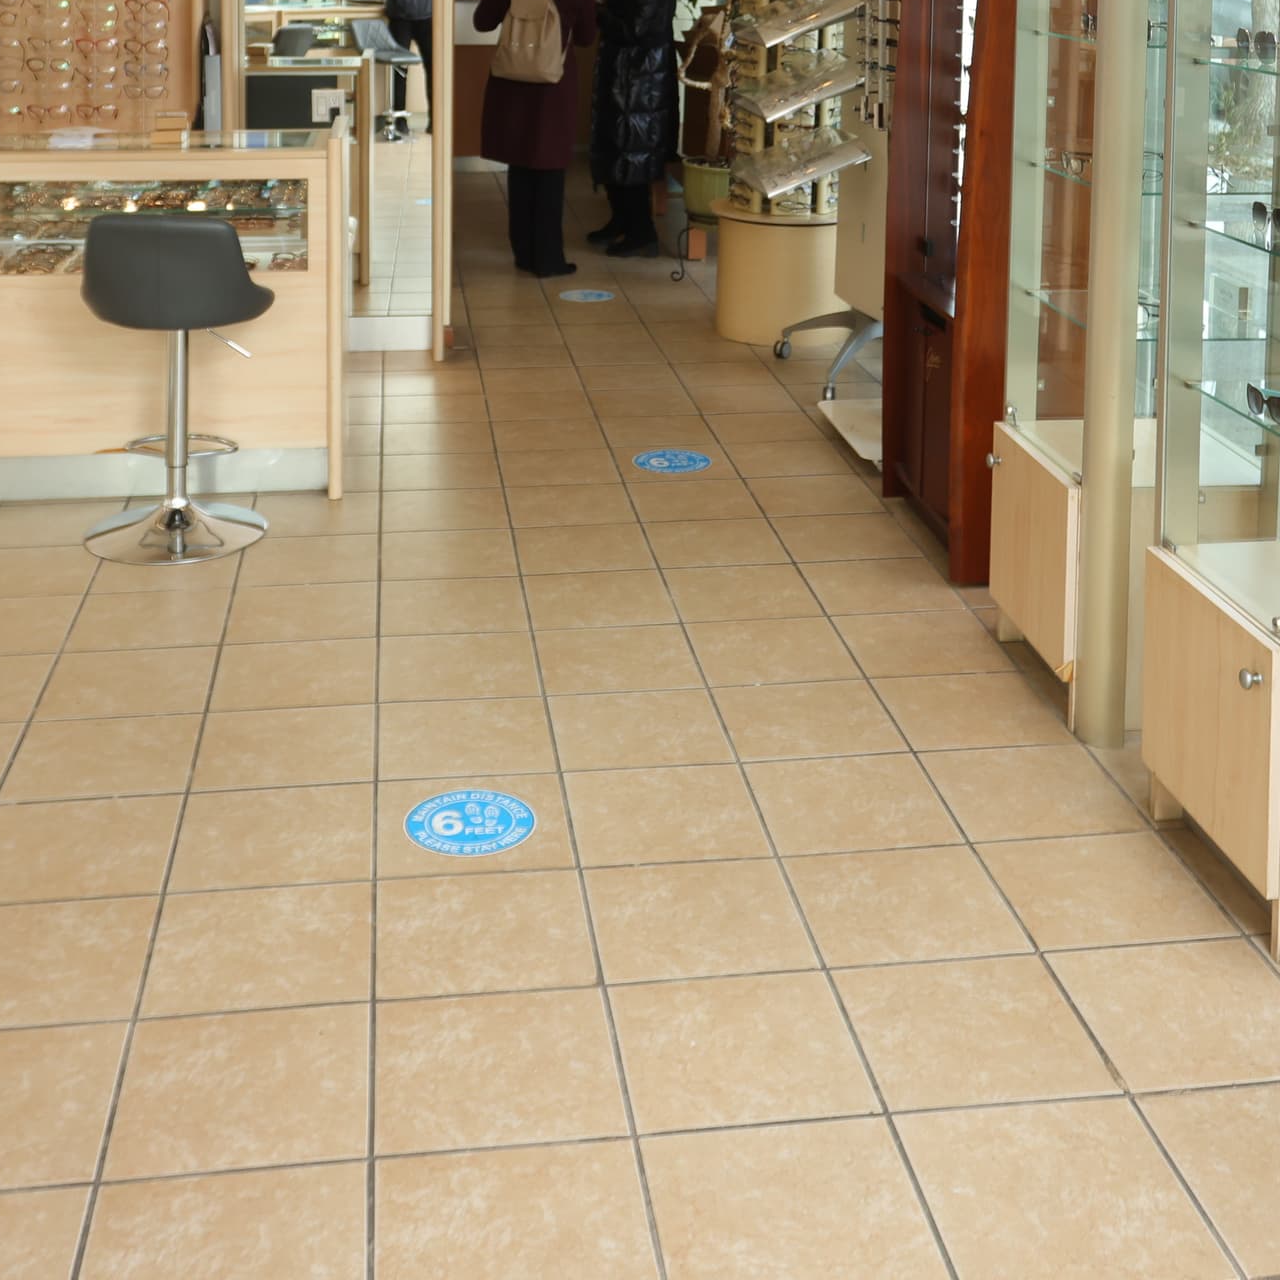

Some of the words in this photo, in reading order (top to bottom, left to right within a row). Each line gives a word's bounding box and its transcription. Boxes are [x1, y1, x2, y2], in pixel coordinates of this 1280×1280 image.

[412, 793, 467, 822] MAINTAIN
[470, 793, 529, 820] DISTANCE
[431, 810, 464, 837] 6
[464, 826, 505, 836] FEET
[415, 831, 459, 854] PLEASE
[462, 841, 498, 854] STAY
[497, 827, 528, 847] HERE
